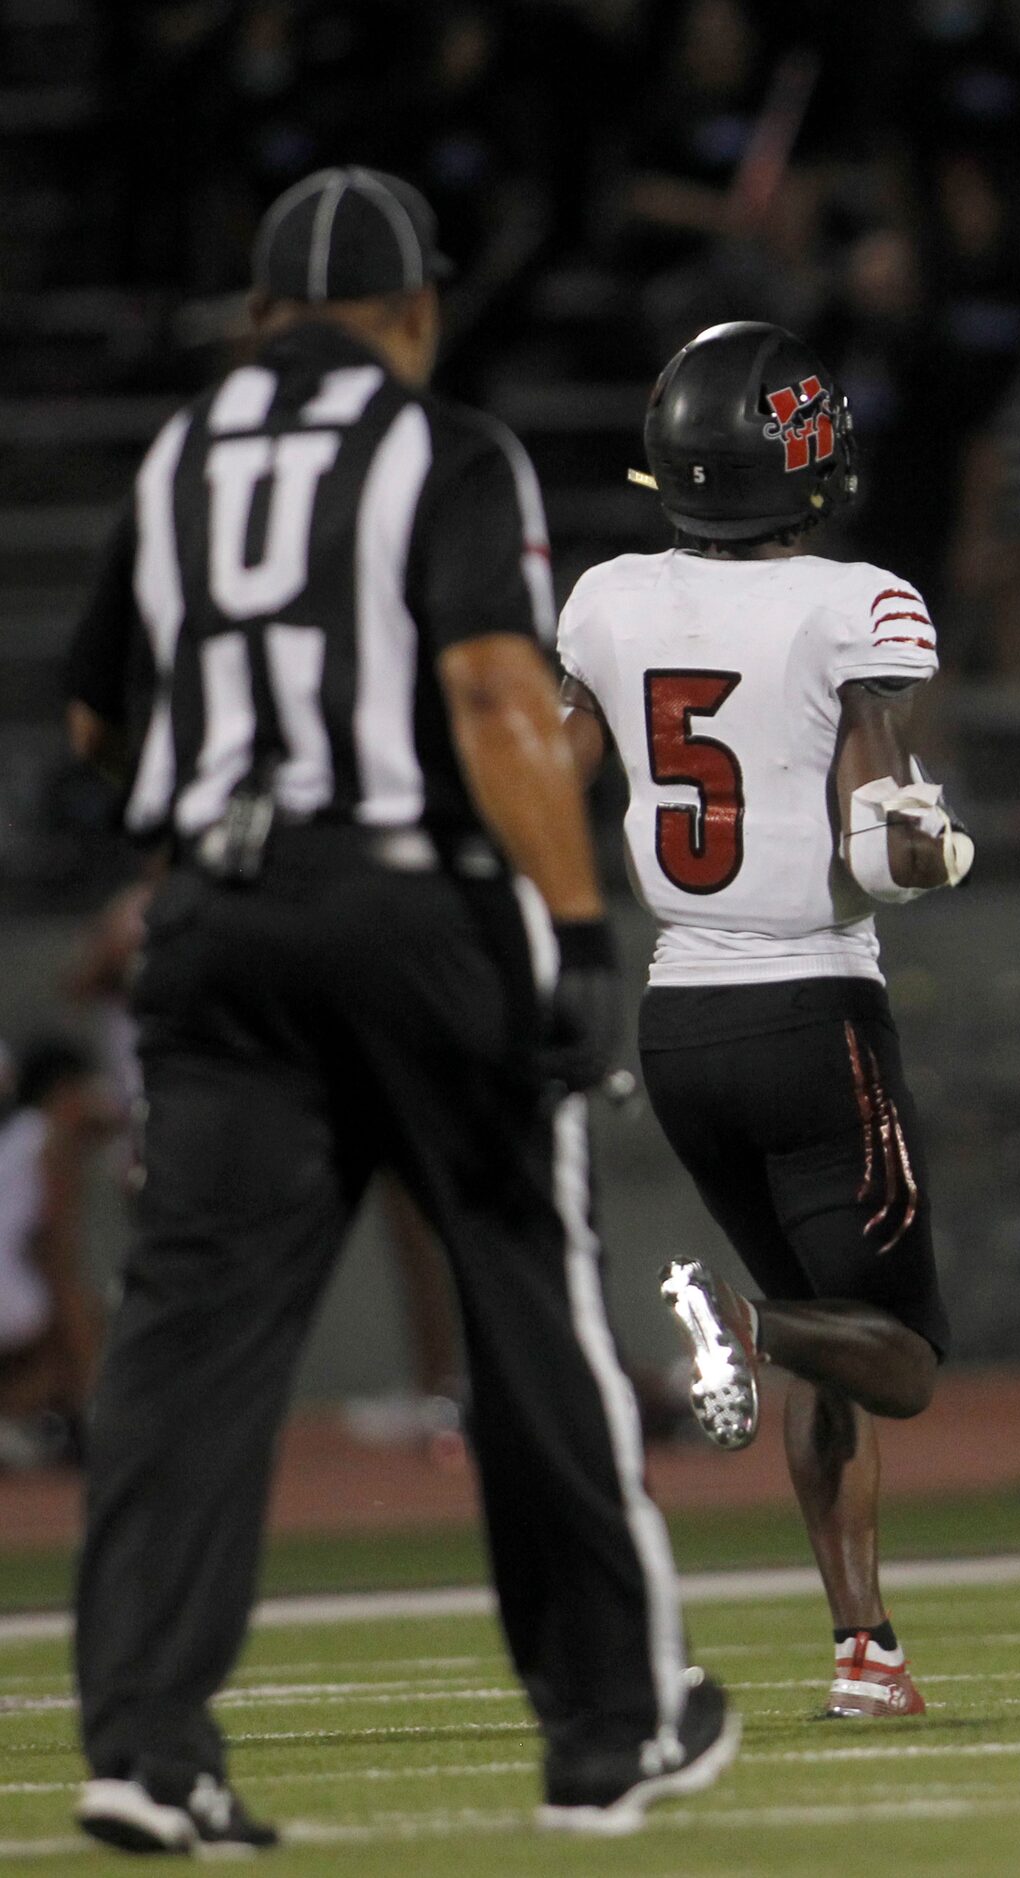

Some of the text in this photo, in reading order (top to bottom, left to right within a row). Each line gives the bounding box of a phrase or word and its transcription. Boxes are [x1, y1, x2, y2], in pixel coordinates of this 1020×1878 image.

[206, 430, 342, 621] U
[693, 466, 706, 484] 5
[643, 667, 746, 896] 5
